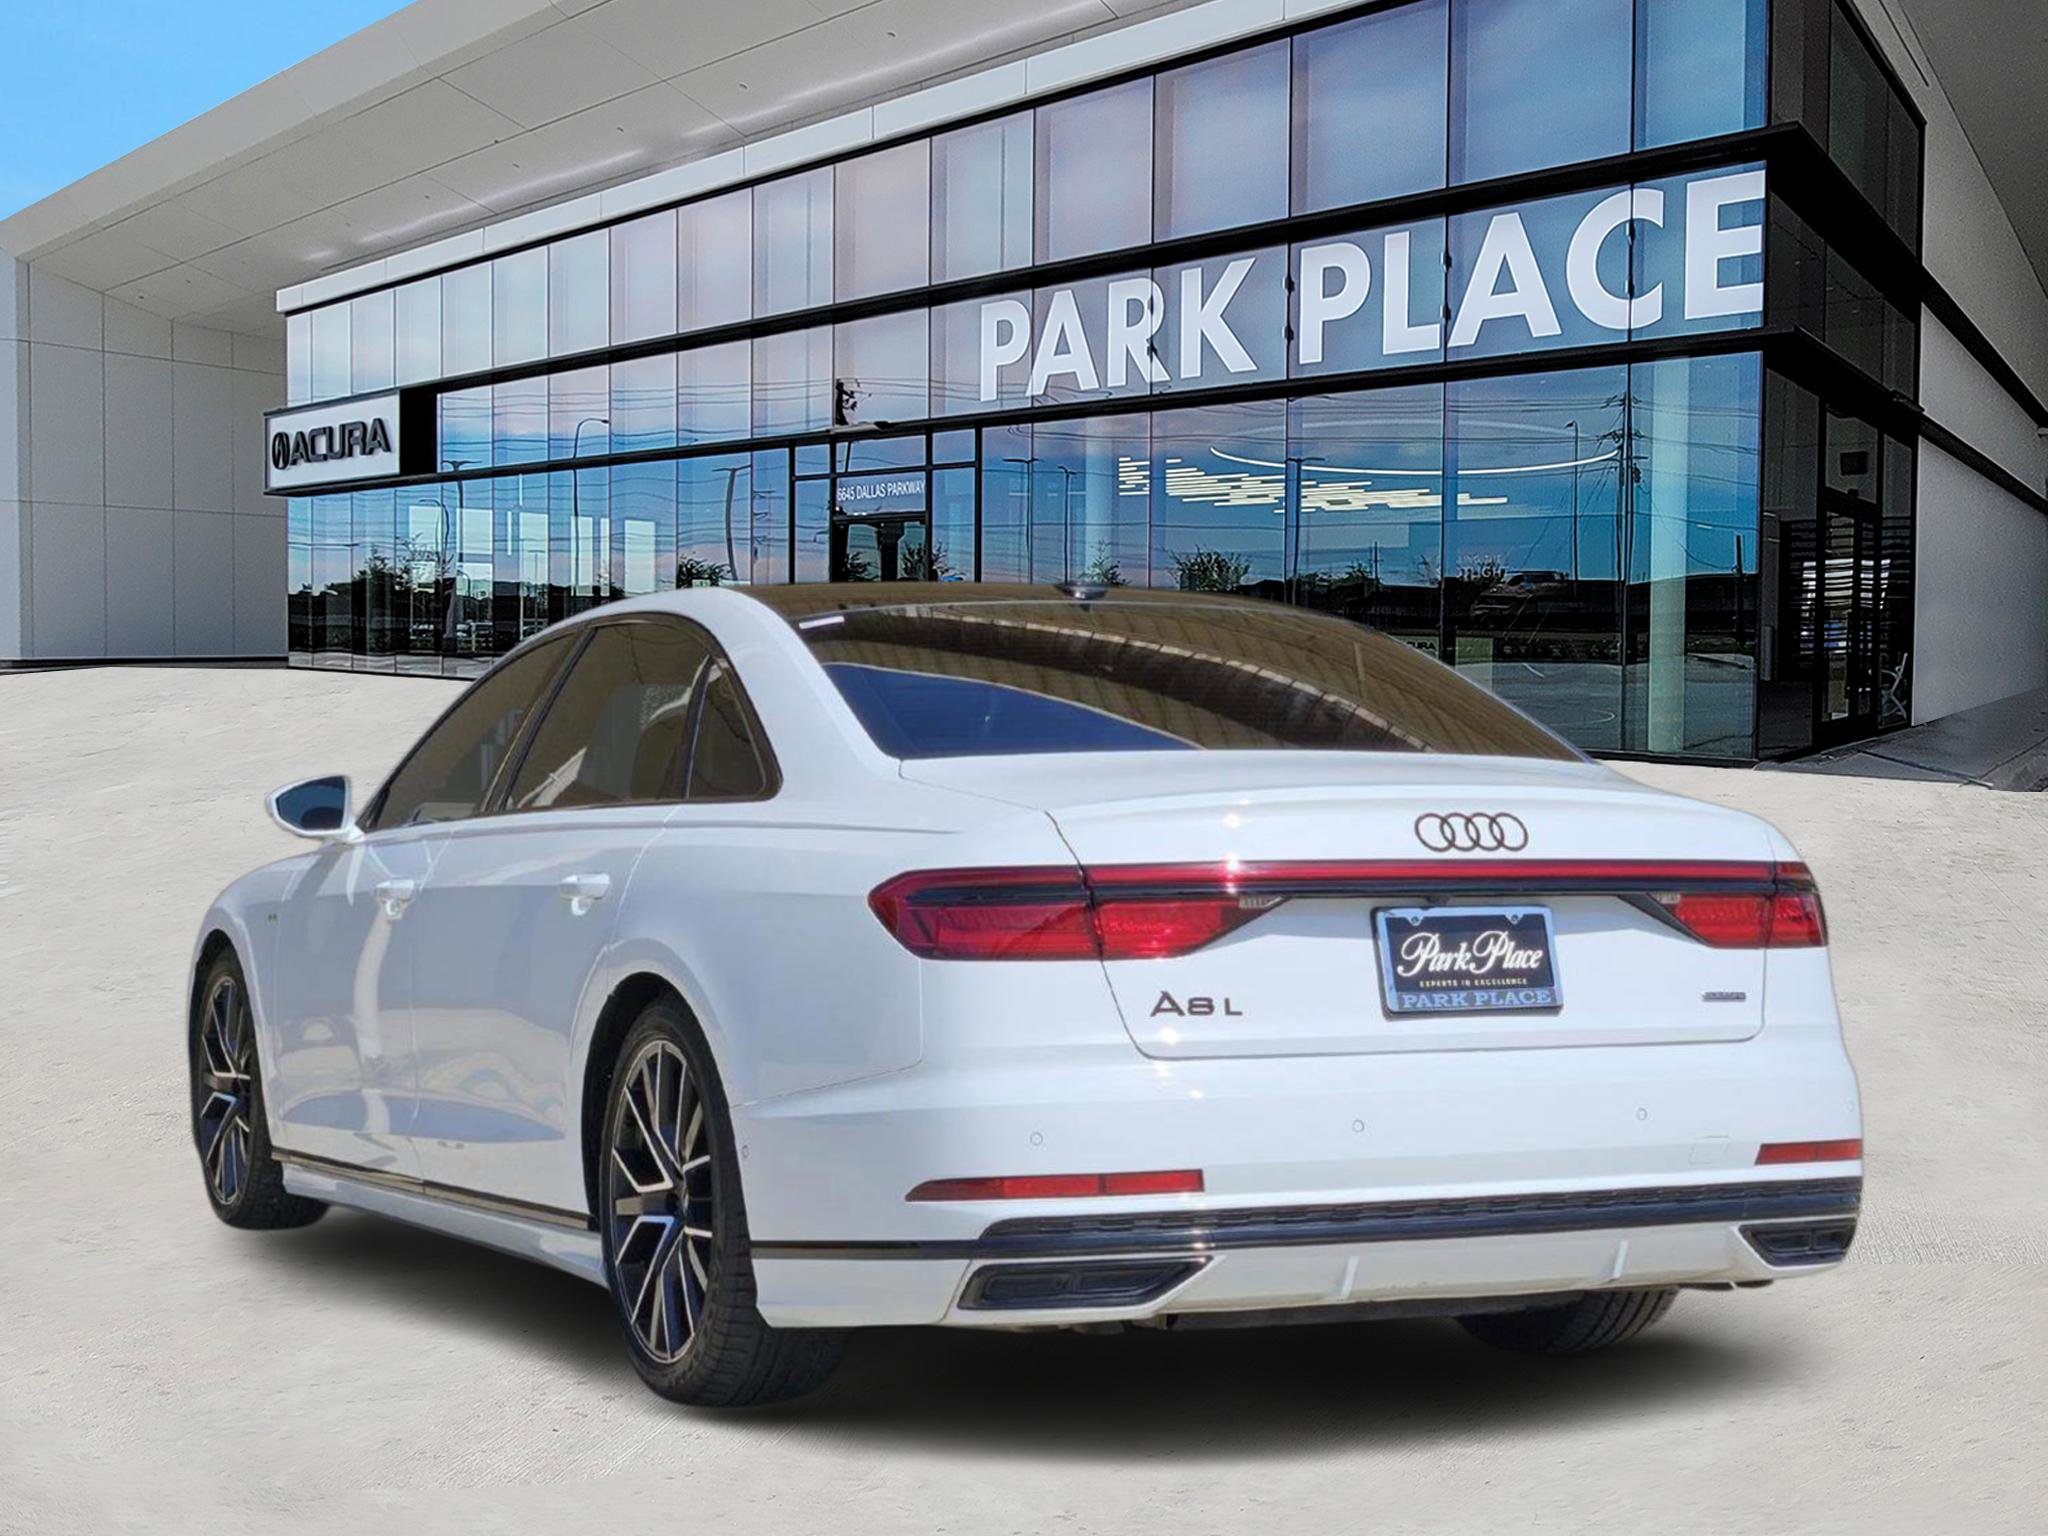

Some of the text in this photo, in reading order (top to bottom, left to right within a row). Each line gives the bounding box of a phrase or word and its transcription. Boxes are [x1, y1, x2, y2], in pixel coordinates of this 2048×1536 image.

[979, 169, 1766, 402] PARK PLACE
[290, 417, 392, 466] ACURA
[856, 483, 886, 499] DALLAS
[887, 480, 925, 497] PARKWAY
[1397, 930, 1543, 977] Park Place
[1150, 990, 1243, 1017] A8 L
[1402, 990, 1551, 1008] PARK PLACE
